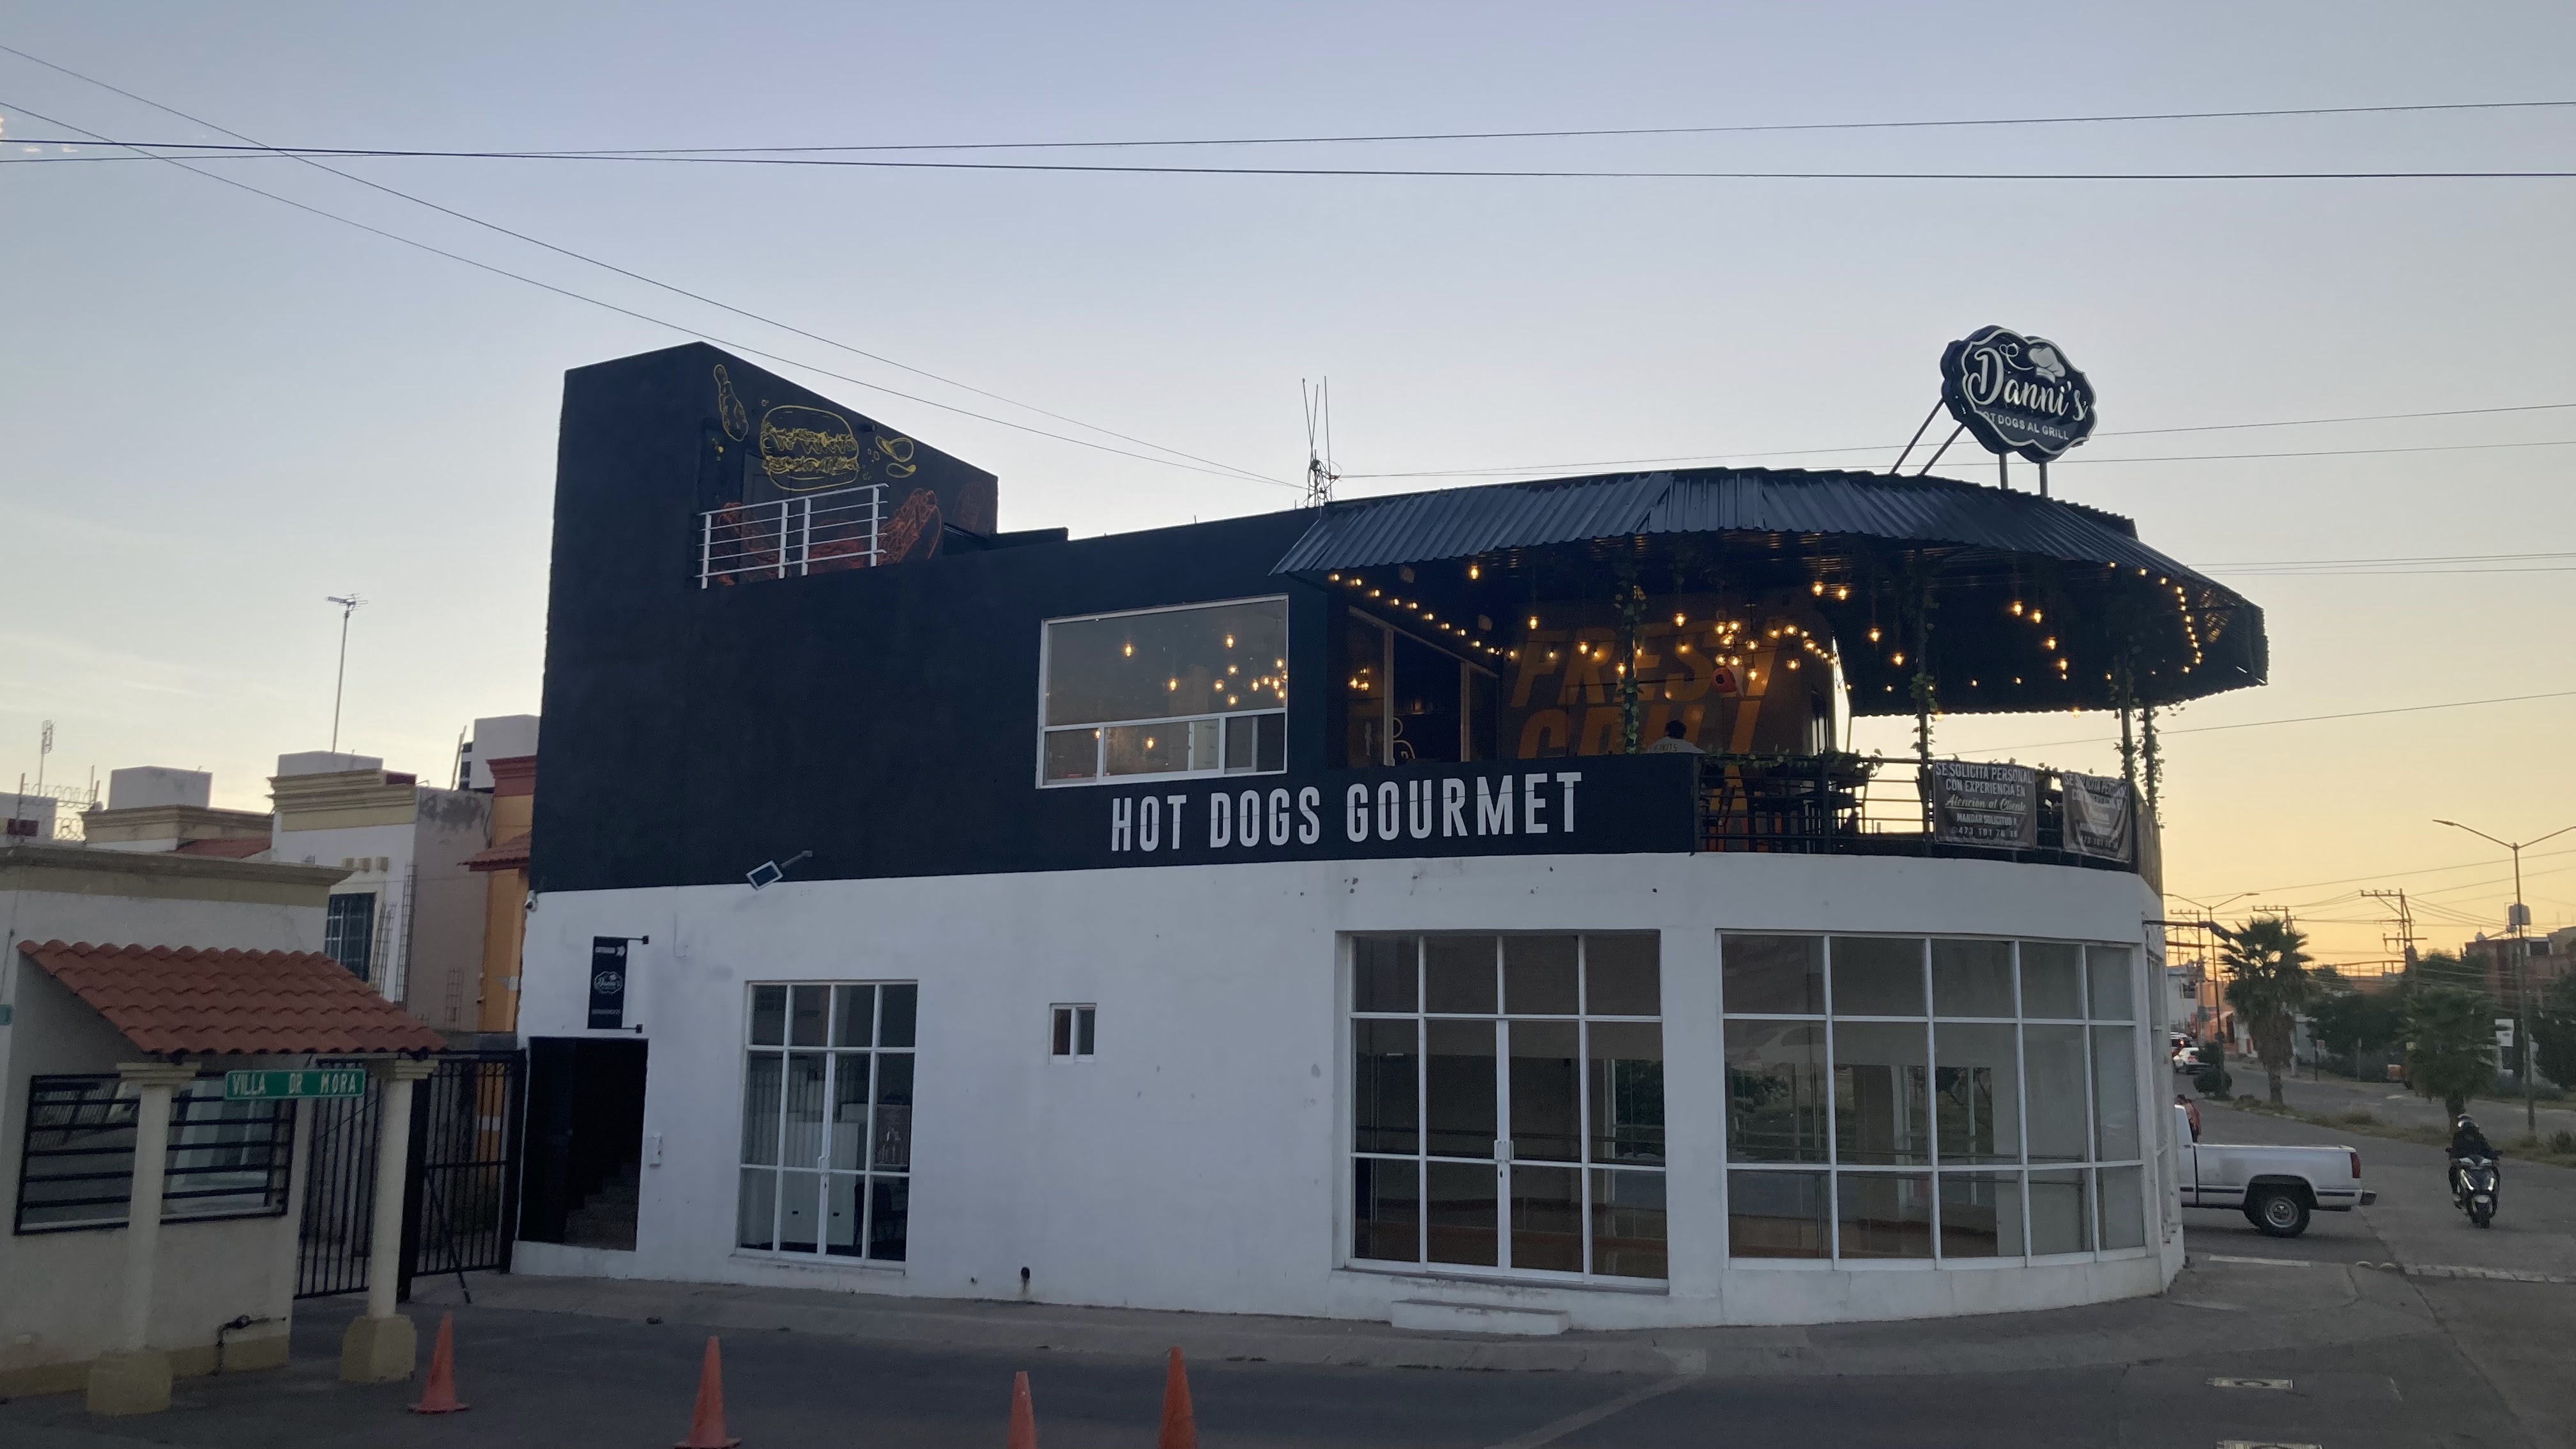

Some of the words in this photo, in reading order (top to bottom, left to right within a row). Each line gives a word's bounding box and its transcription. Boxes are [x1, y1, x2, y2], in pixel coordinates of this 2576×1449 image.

[1968, 347, 2089, 421] Danni's
[1998, 415, 2025, 429] DOGS
[2027, 422, 2040, 433] AL
[2042, 425, 2069, 440] GRILL
[1936, 762, 1948, 776] SE
[1950, 763, 1989, 779] SOLICITA
[1991, 767, 2032, 783] PERSONAL
[1946, 778, 1963, 792] CON
[1965, 780, 2015, 796] EXPERIENCIA
[2016, 785, 2026, 797] EN
[1112, 795, 1187, 852] HOT
[1210, 786, 1321, 848] DOGS
[1346, 772, 1582, 842] GOURMET
[1989, 799, 1997, 808] al
[1956, 813, 1983, 824] MANDAR
[1983, 815, 2012, 825] SOLICITUD
[1958, 827, 1974, 835] 473
[1979, 828, 1992, 836] 101
[233, 1073, 266, 1095] VILLA
[320, 1073, 356, 1094] MORA
